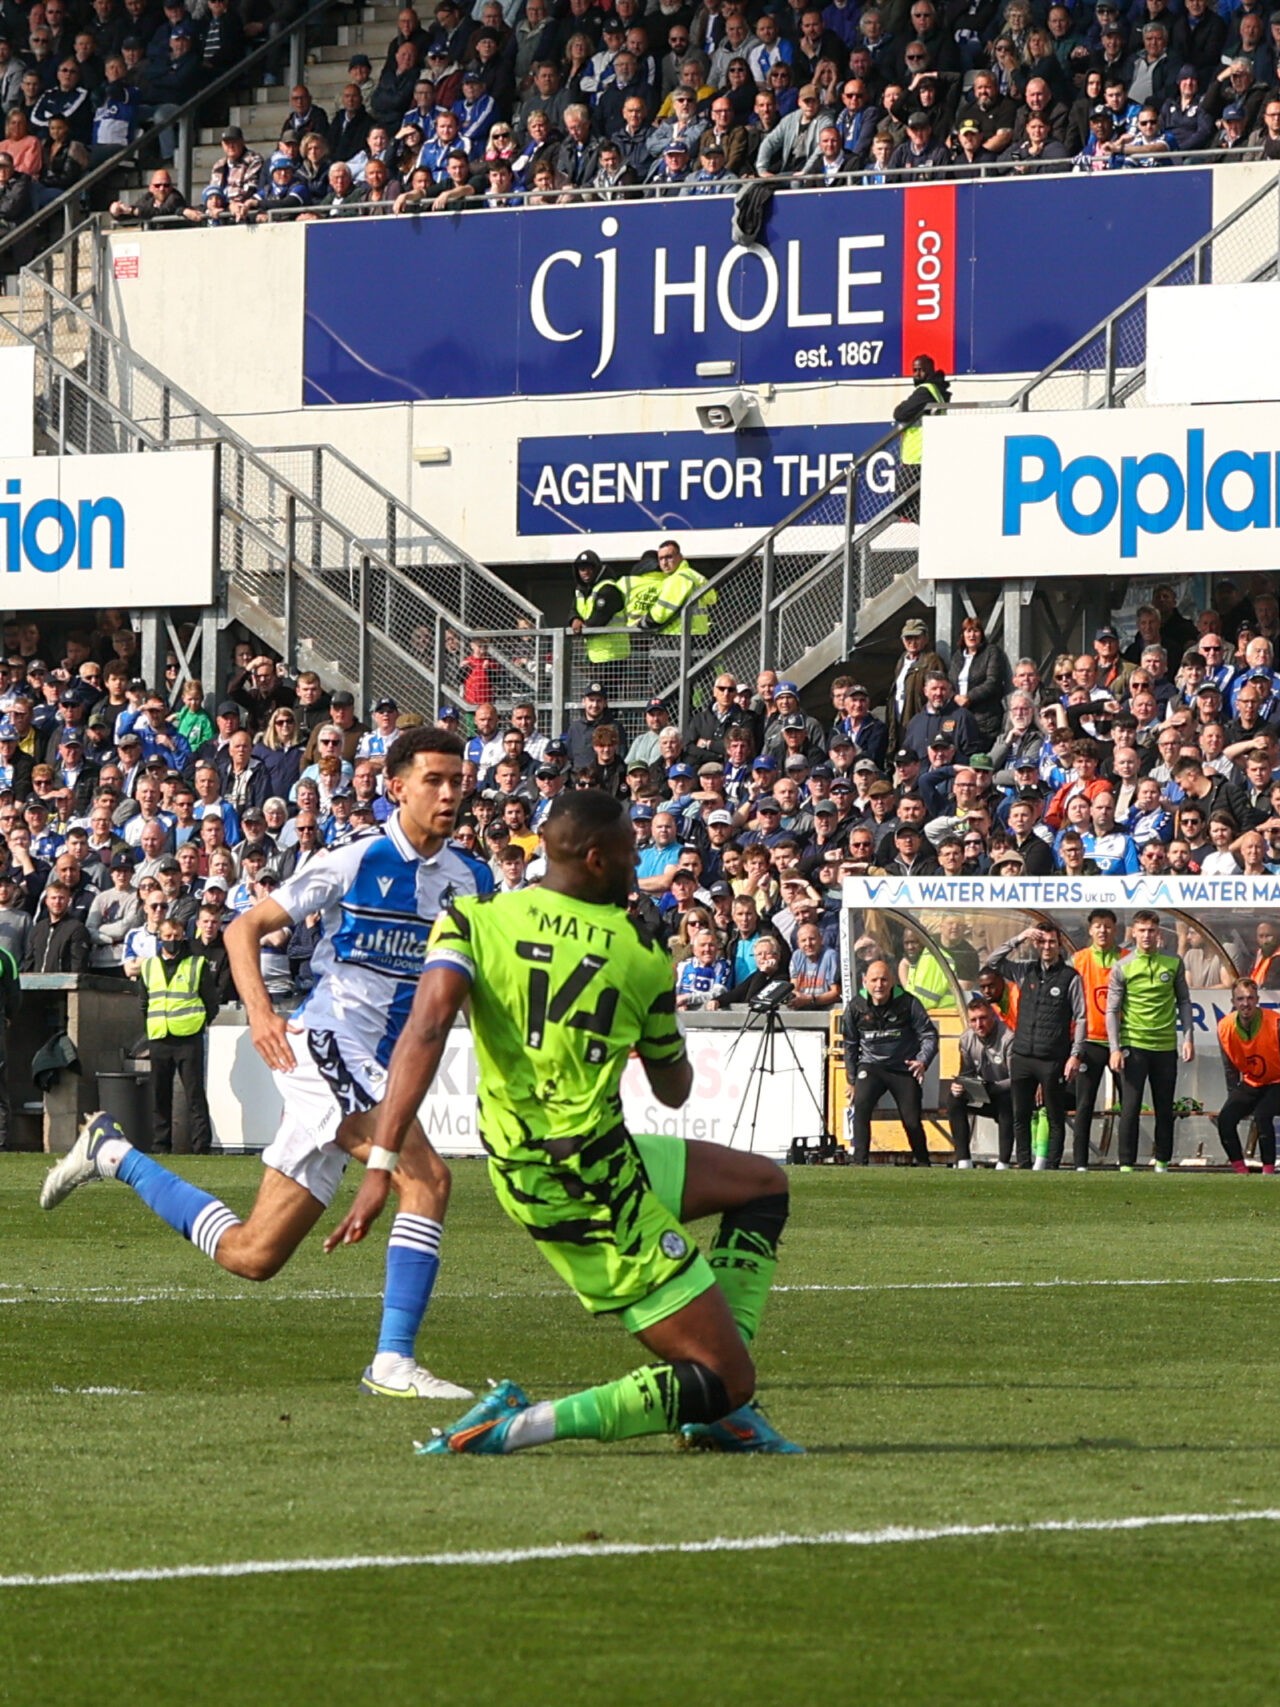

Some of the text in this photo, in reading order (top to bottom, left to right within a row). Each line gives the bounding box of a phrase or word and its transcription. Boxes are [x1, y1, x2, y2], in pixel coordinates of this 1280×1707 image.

[653, 234, 886, 335] HOLE
[916, 219, 942, 321] .com
[795, 341, 884, 368] est. 1867
[532, 461, 669, 506] AGENT
[680, 457, 762, 500] FOR
[773, 453, 854, 496] THE
[0, 478, 125, 573] ion
[918, 881, 1117, 903] WATER MATTERS UK LTD
[1178, 881, 1247, 901] WATER
[355, 928, 429, 958] utilita
[538, 914, 616, 950] MATT
[515, 940, 621, 1065] 14
[643, 1103, 720, 1139] Safer
